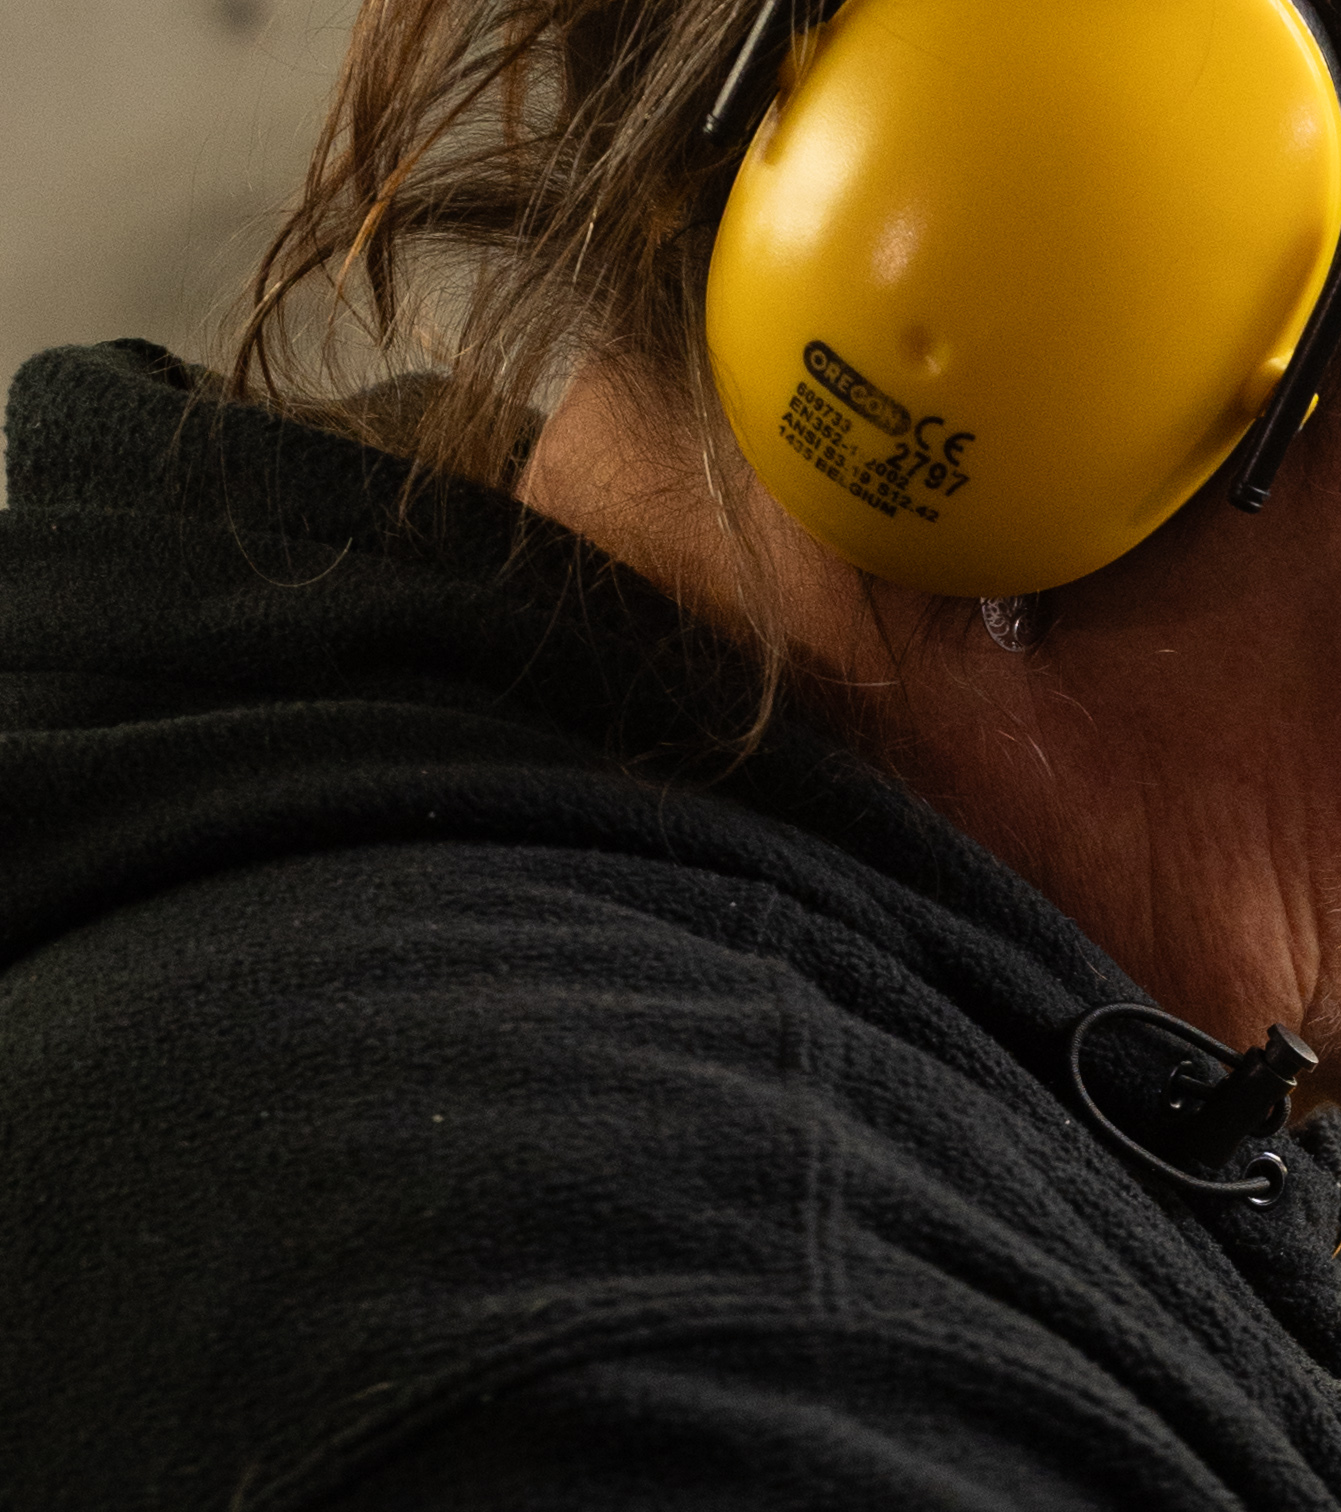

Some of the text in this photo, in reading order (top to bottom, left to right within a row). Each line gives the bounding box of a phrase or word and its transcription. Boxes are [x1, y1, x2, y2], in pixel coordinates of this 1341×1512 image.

[782, 412, 822, 450] ANSI
[796, 382, 851, 434] 609733
[886, 443, 970, 496] 2797
